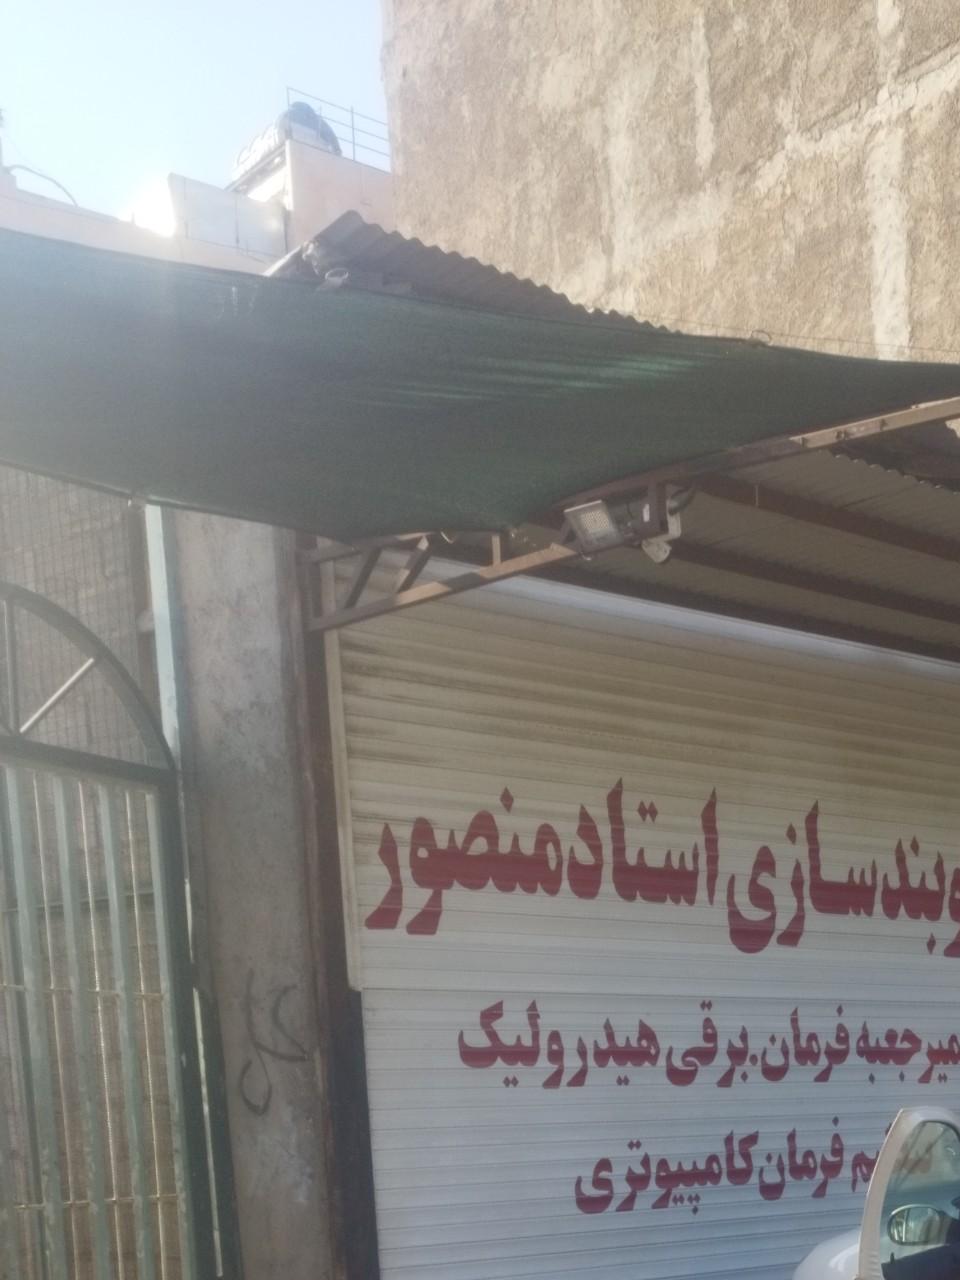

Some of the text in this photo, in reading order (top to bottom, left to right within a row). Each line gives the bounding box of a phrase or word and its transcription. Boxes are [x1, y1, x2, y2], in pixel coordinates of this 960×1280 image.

[364, 786, 563, 935] منصور
[566, 778, 719, 906] استاد
[855, 1020, 922, 1083] جعبه
[573, 1130, 760, 1215] کامپیوتری
[758, 1116, 846, 1199] فرمان
